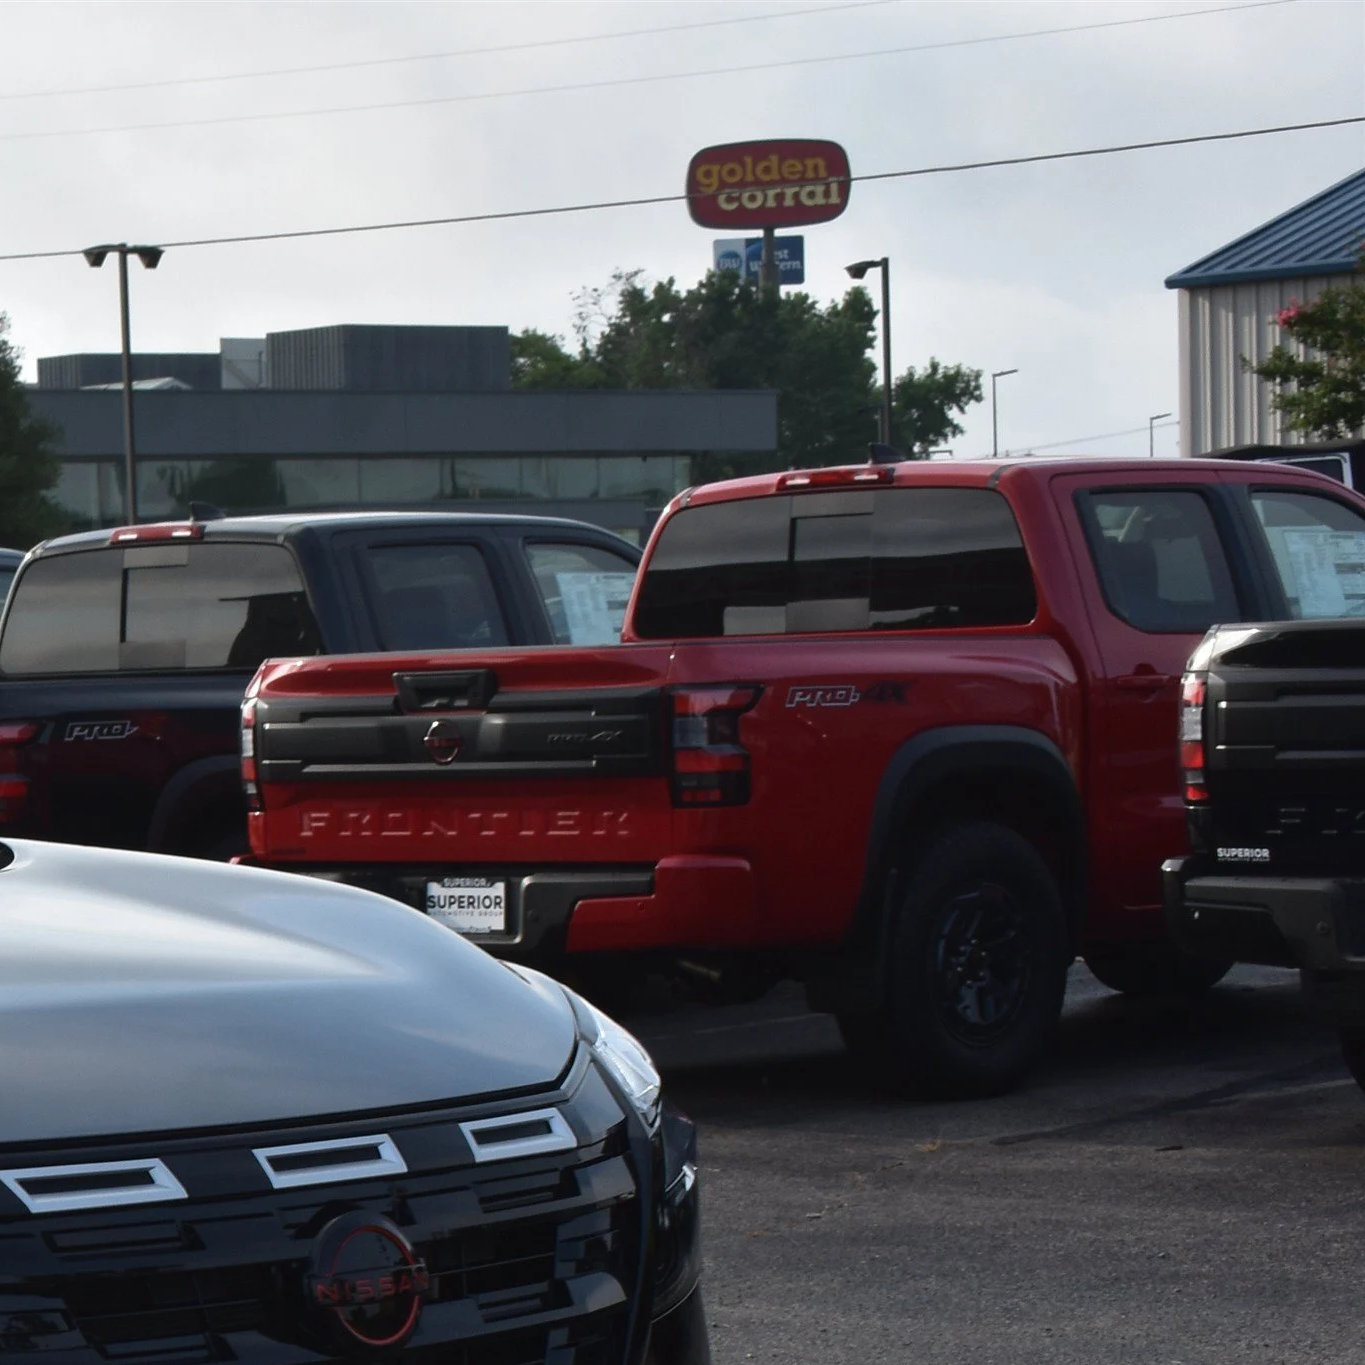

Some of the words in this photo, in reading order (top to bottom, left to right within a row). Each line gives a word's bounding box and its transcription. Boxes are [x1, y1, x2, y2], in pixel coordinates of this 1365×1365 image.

[696, 154, 828, 193] golden
[717, 176, 844, 211] corral
[300, 810, 630, 836] FRONTIER
[1216, 848, 1270, 858] SUPERIOR
[443, 877, 488, 887] SUPERIOR
[427, 895, 503, 909] SUPERIOR
[315, 1270, 430, 1303] NISSAN
